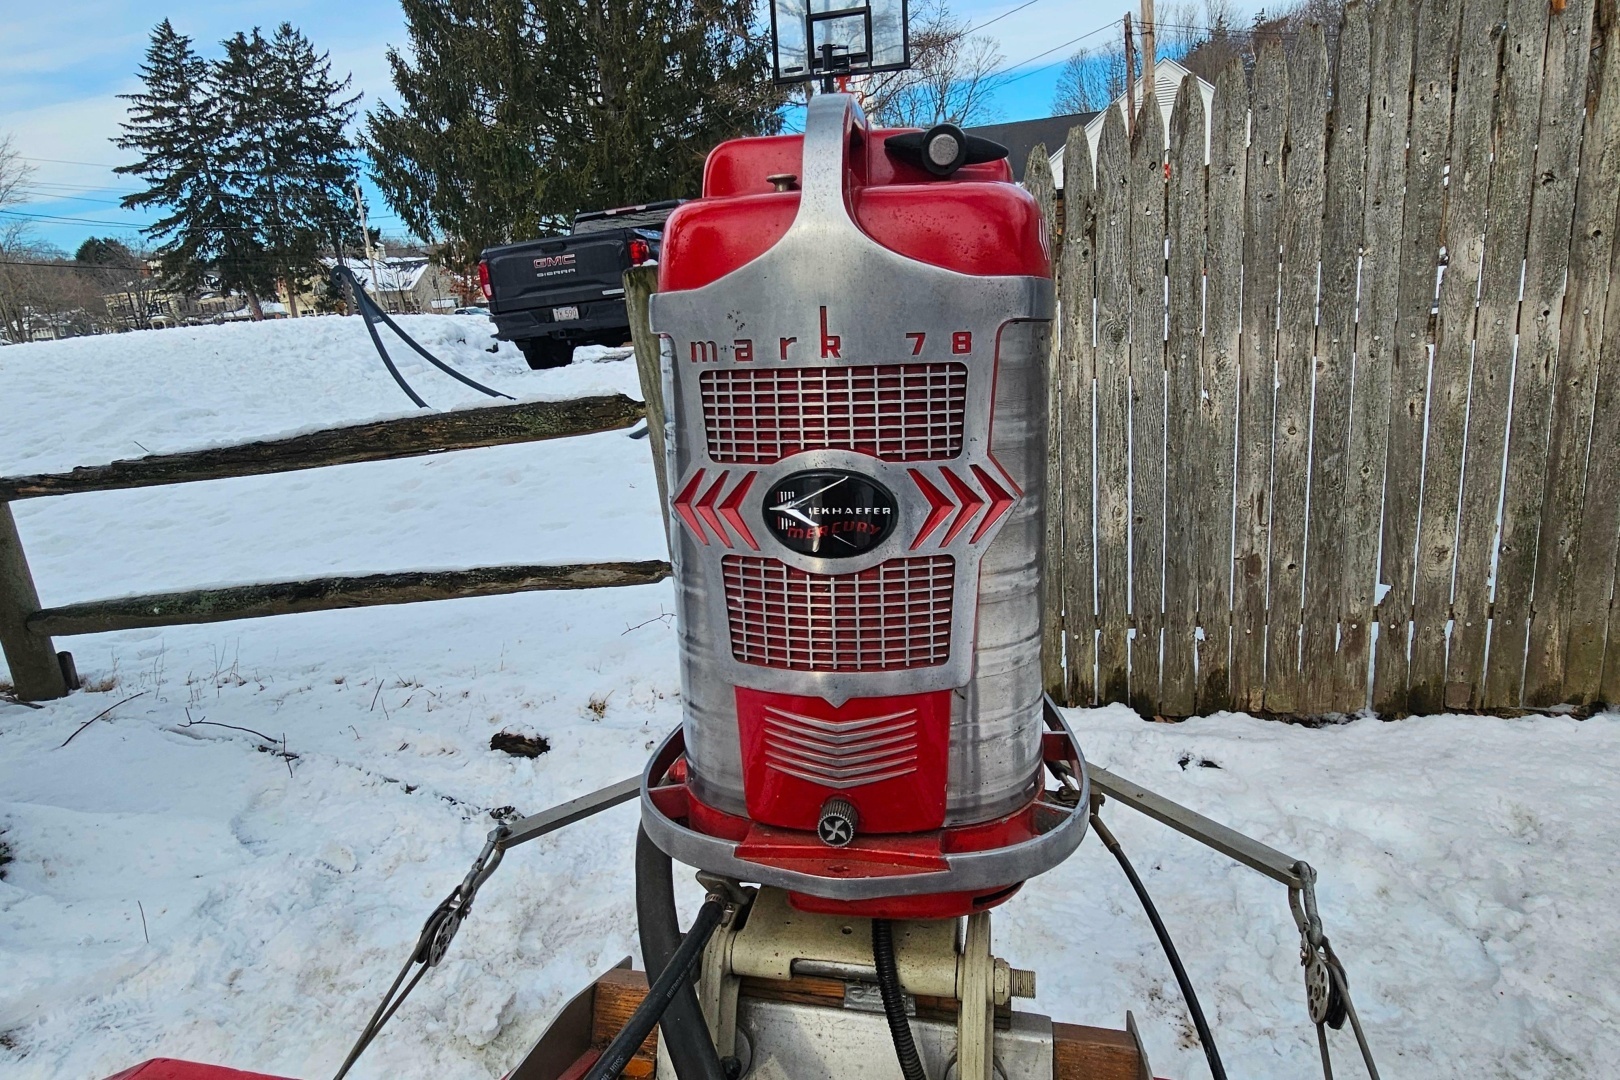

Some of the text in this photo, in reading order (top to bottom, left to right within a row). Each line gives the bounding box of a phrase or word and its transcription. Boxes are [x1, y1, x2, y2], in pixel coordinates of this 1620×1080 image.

[534, 254, 576, 268] GMC
[537, 268, 576, 278] SIERRA
[690, 306, 972, 363] mark 78
[787, 521, 881, 539] MERCURY
